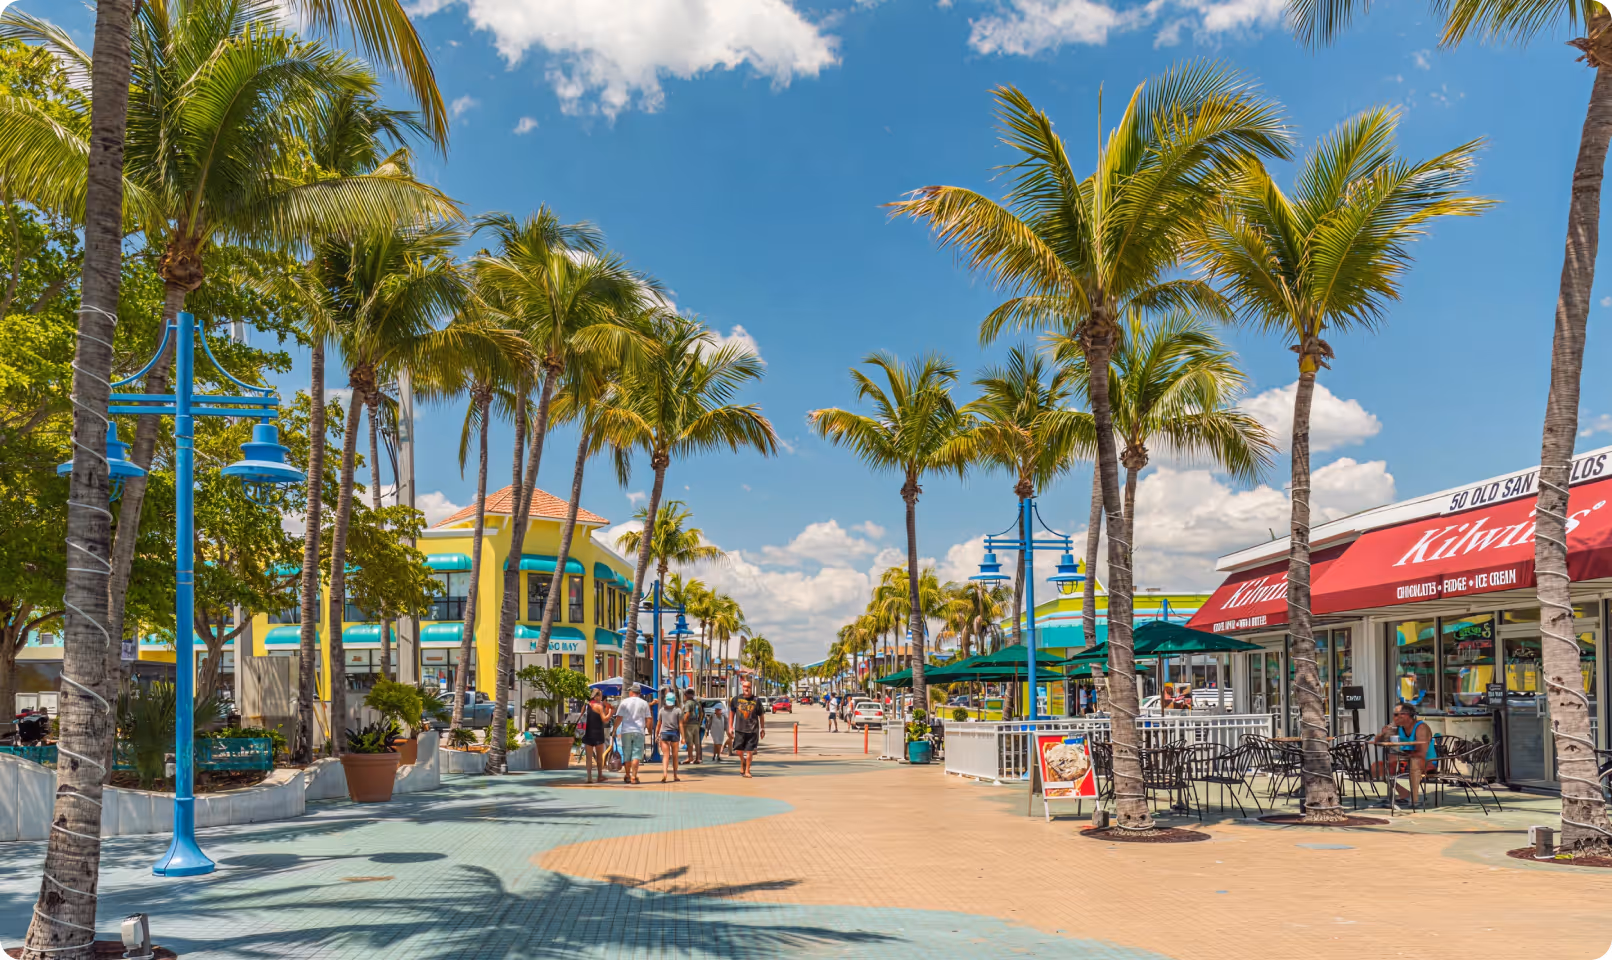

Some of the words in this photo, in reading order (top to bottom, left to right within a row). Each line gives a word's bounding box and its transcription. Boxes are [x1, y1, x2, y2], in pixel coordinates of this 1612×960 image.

[1450, 491, 1468, 511] 50
[1471, 483, 1499, 506] OLD
[1502, 473, 1535, 498] SAN
[1571, 455, 1607, 481] LOS
[1444, 577, 1467, 593] FUDGE
[1475, 573, 1488, 589] ICE
[1490, 568, 1517, 587] CREAM
